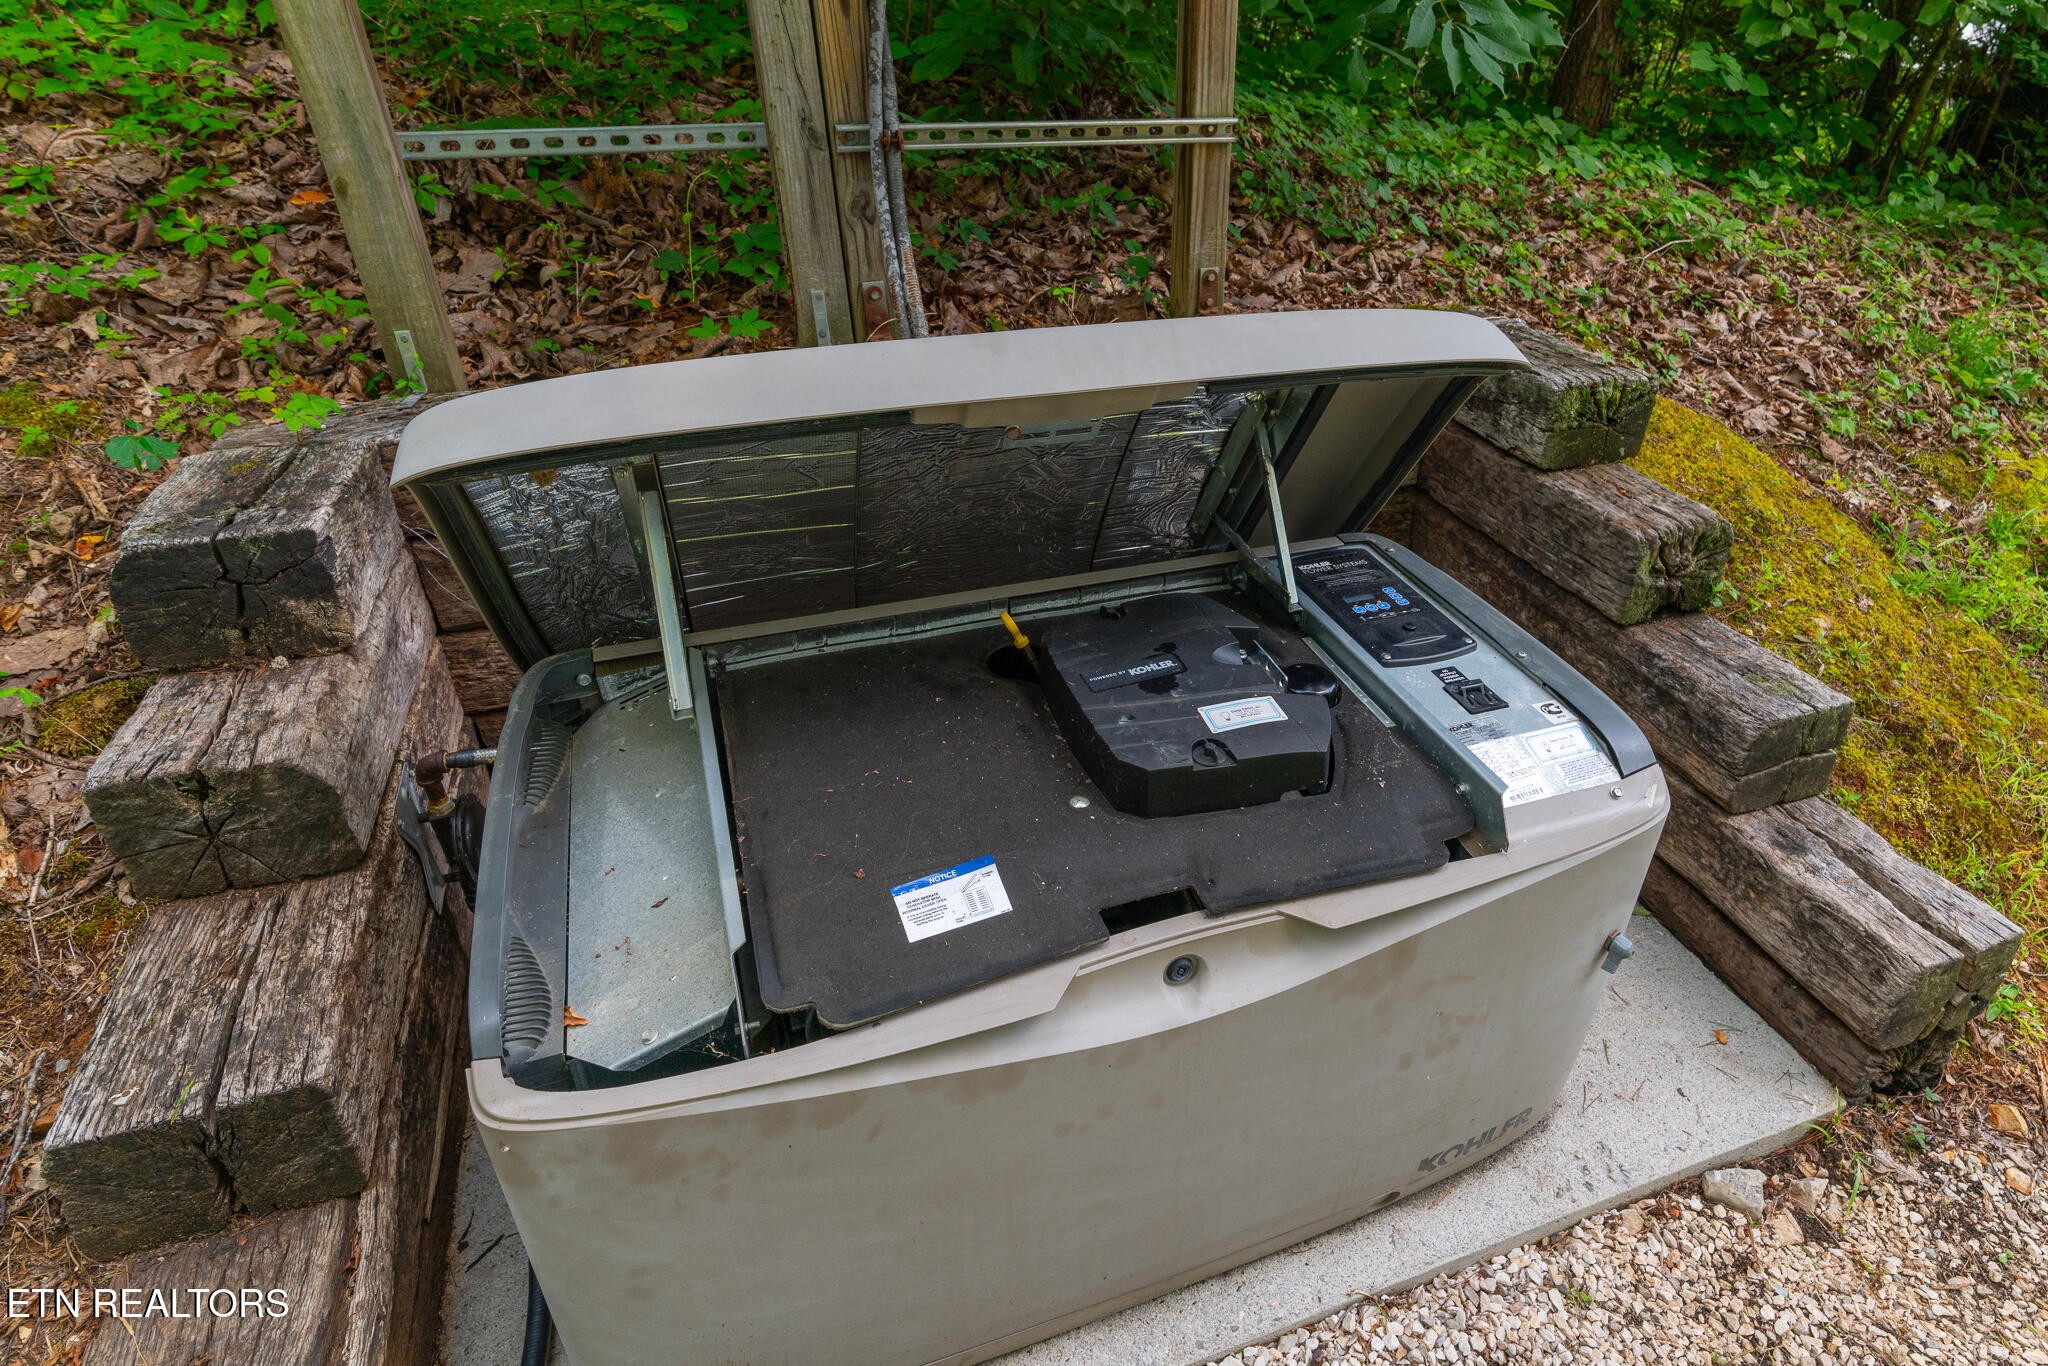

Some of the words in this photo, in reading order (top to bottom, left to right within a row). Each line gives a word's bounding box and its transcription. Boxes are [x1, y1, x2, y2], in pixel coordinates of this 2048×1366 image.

[1302, 565, 1333, 574] POWER
[1333, 559, 1368, 569] SYSTEMS
[1089, 672, 1118, 682] POWERED
[928, 870, 957, 884] NOTICE
